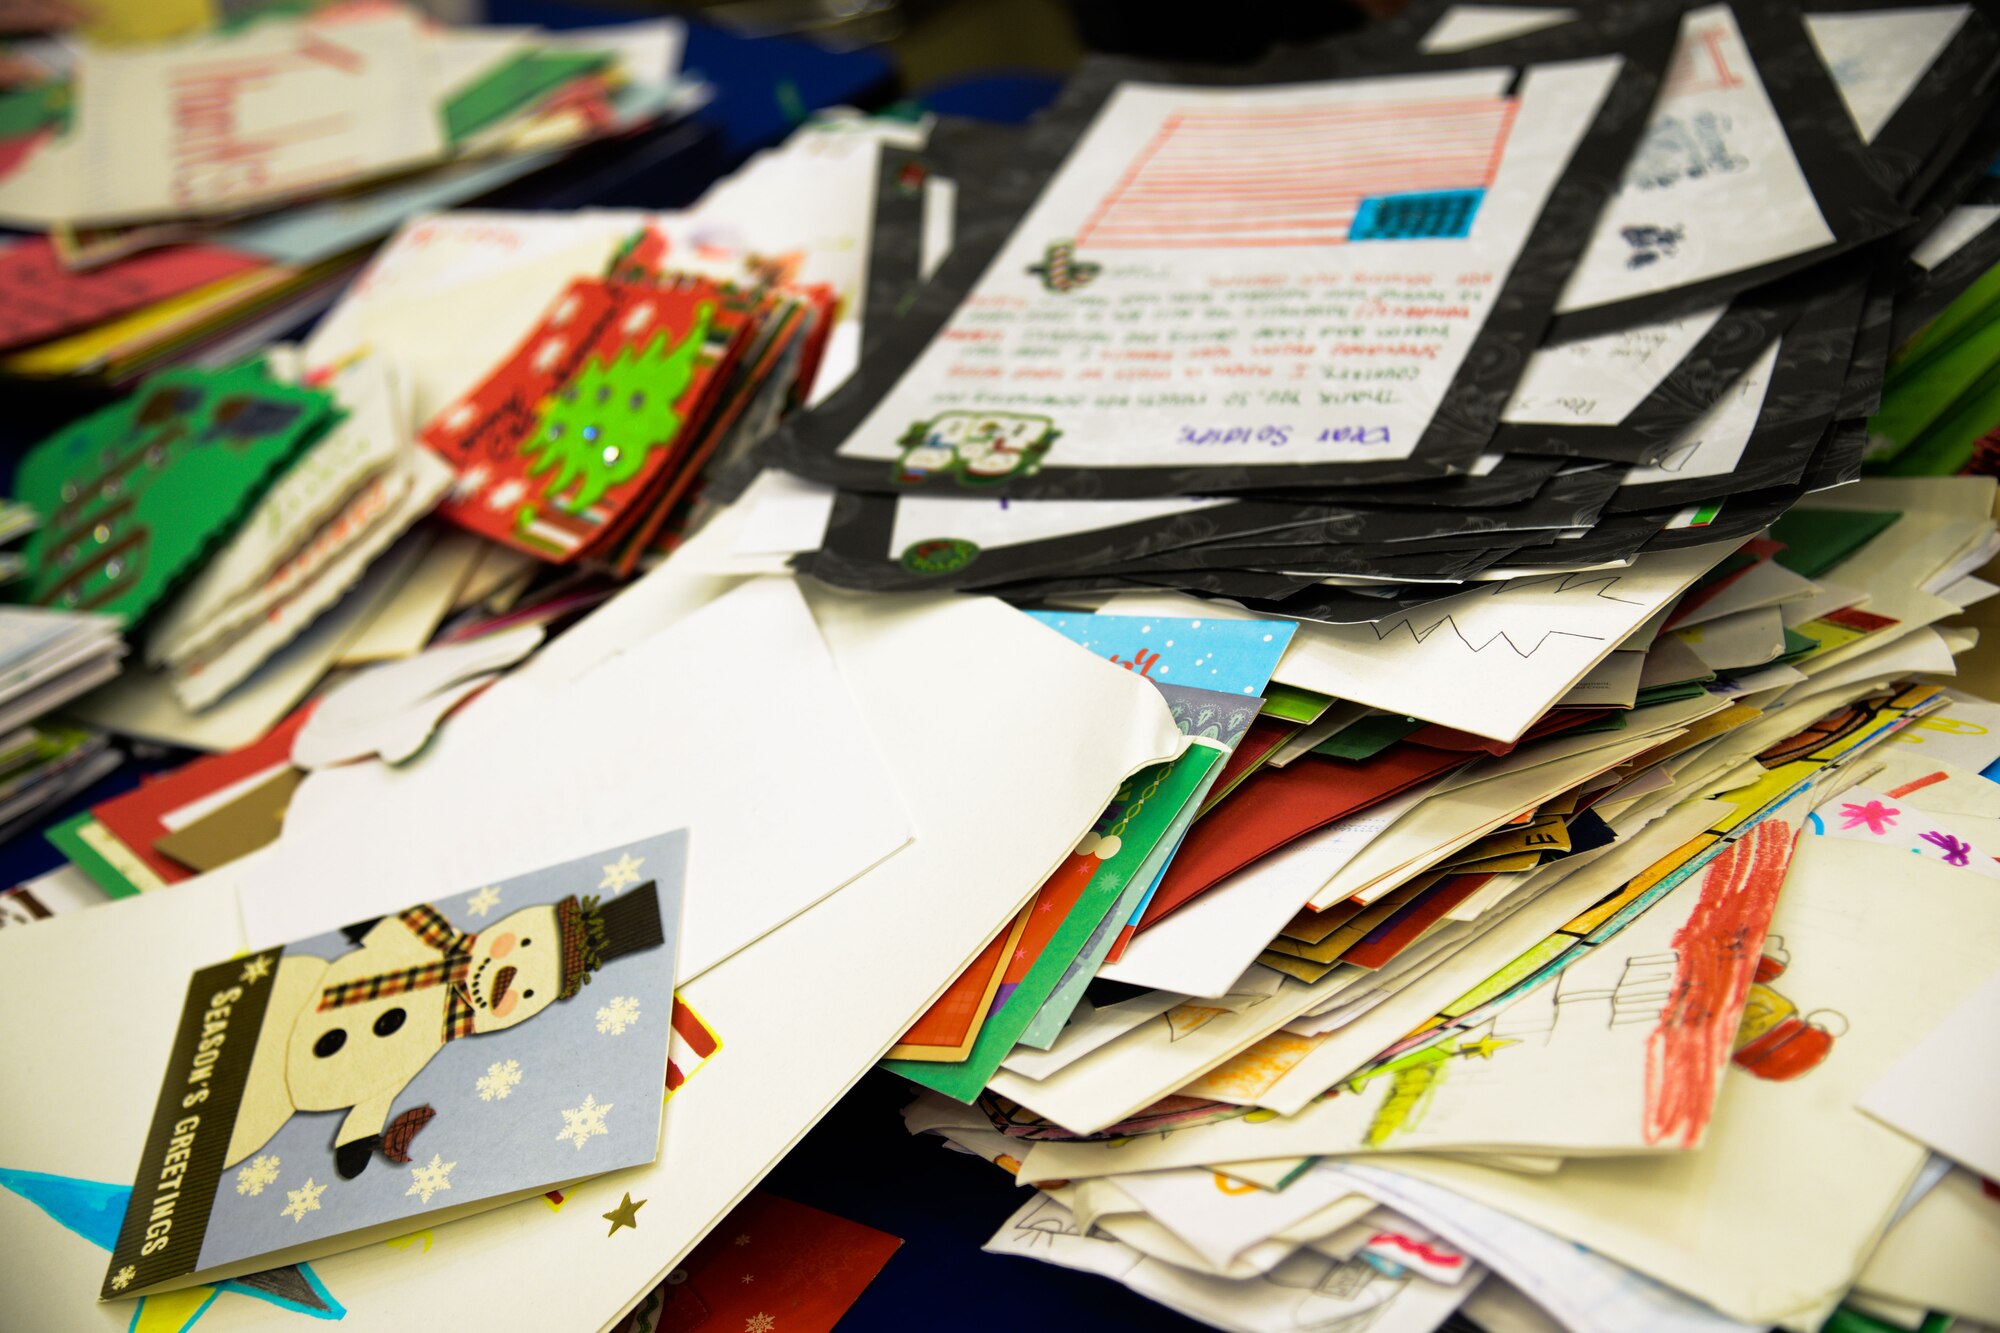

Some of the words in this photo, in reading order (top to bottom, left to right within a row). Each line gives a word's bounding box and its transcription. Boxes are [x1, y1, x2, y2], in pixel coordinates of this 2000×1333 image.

[1316, 424, 1391, 444] Dear
[182, 985, 243, 1108] SEASON'S
[140, 1115, 200, 1256] GREETINGS
